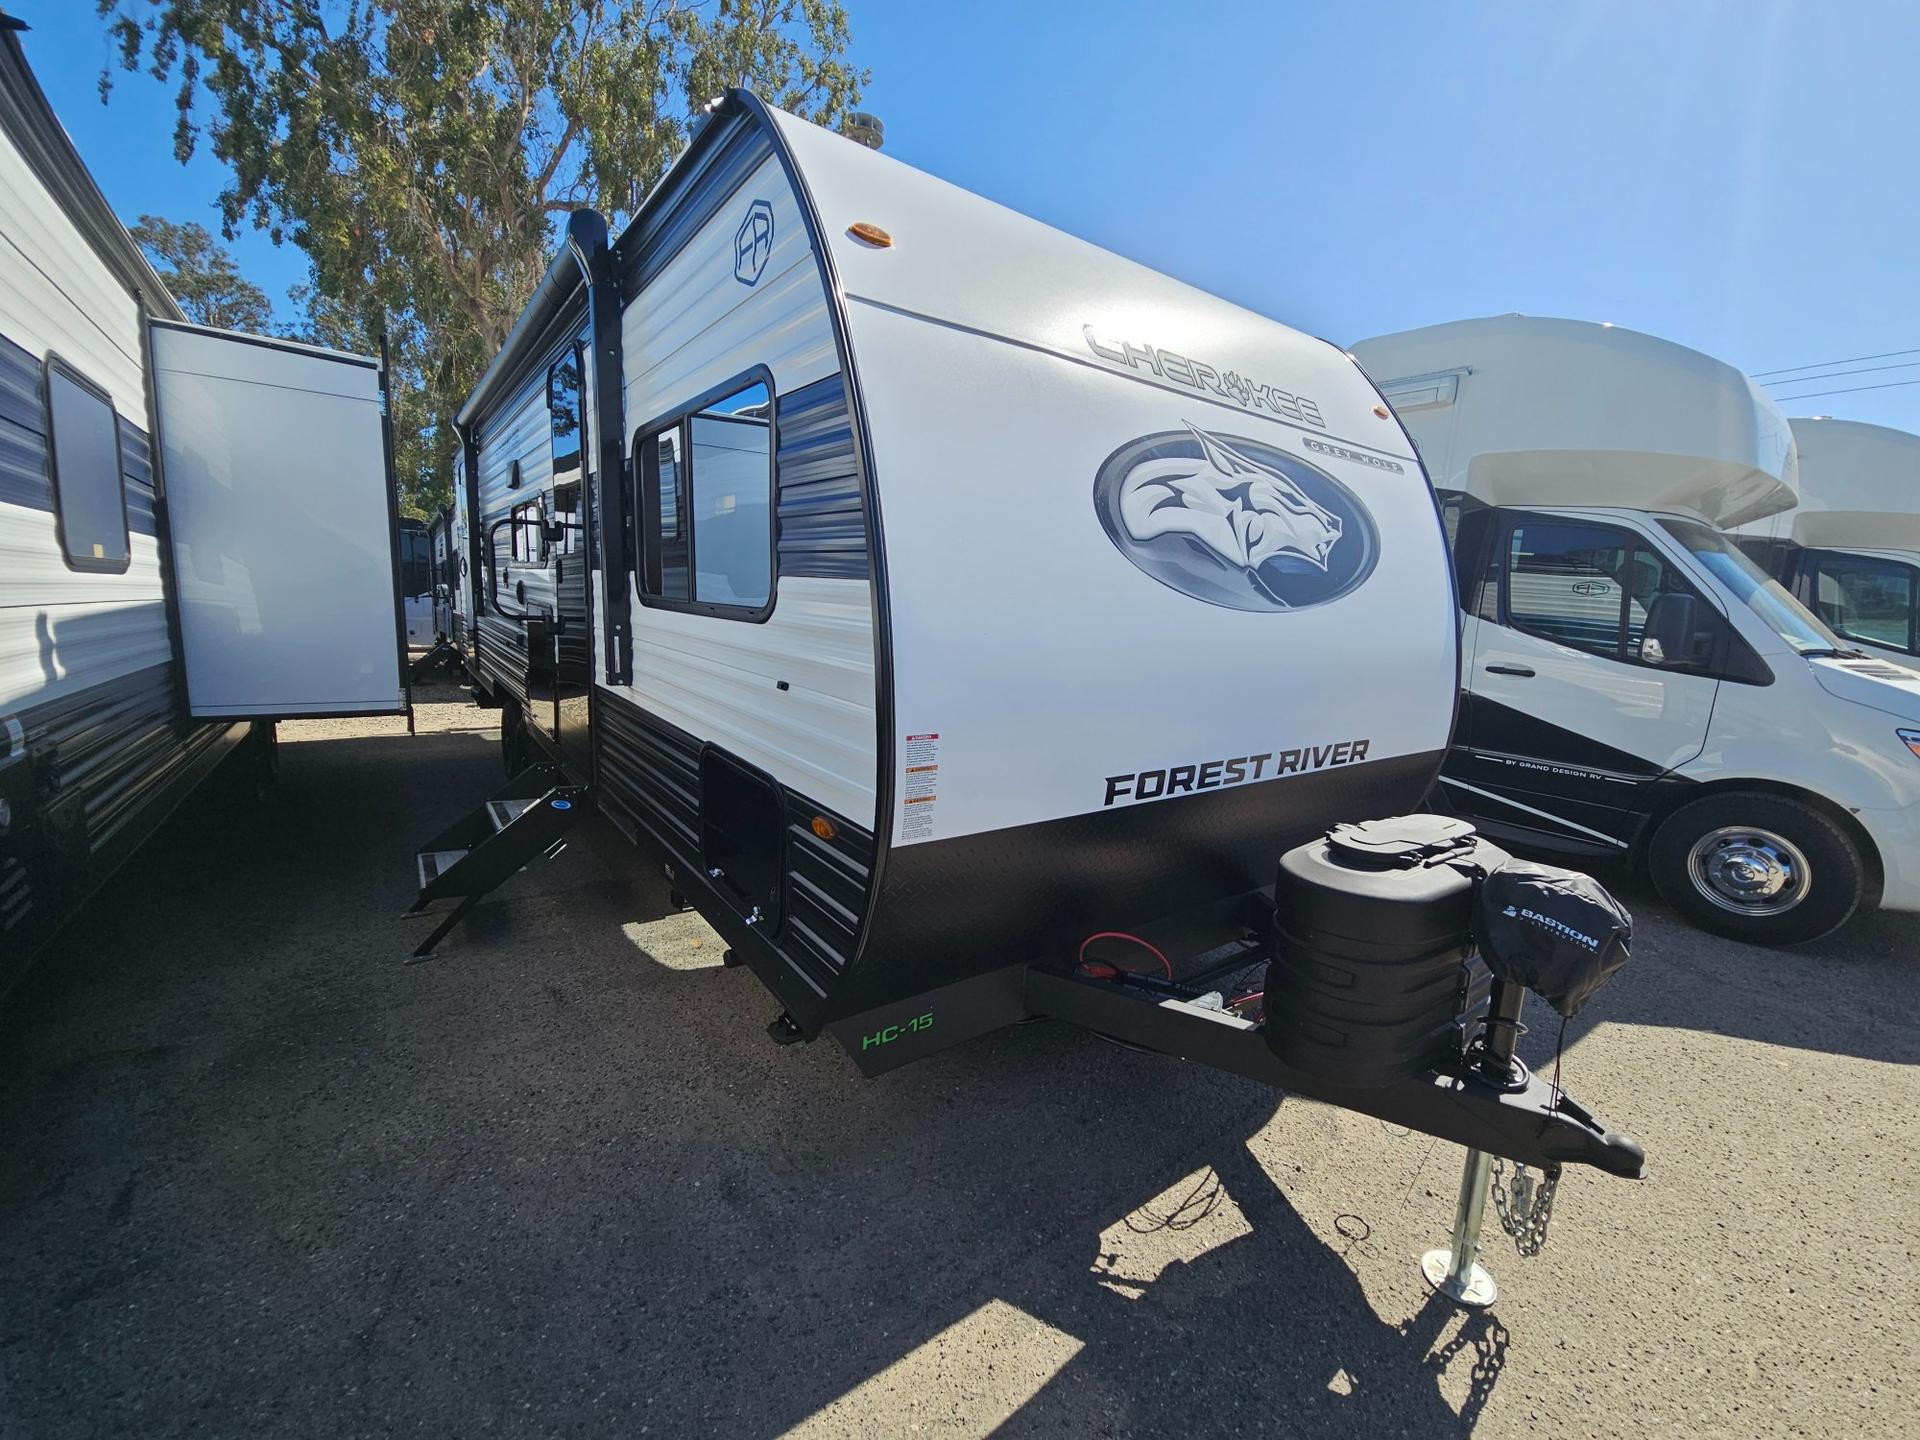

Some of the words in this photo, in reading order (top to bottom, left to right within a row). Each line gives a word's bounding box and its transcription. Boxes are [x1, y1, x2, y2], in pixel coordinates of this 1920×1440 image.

[1310, 441, 1352, 459] GREY
[1360, 454, 1400, 471] WOLF
[1104, 753, 1272, 806] FOREST
[1277, 739, 1370, 775] RIVER
[1519, 762, 1550, 771] GRAND
[1552, 767, 1587, 778] DESIGN
[1520, 908, 1599, 948] BASTION
[862, 1012, 934, 1051] HC-15
